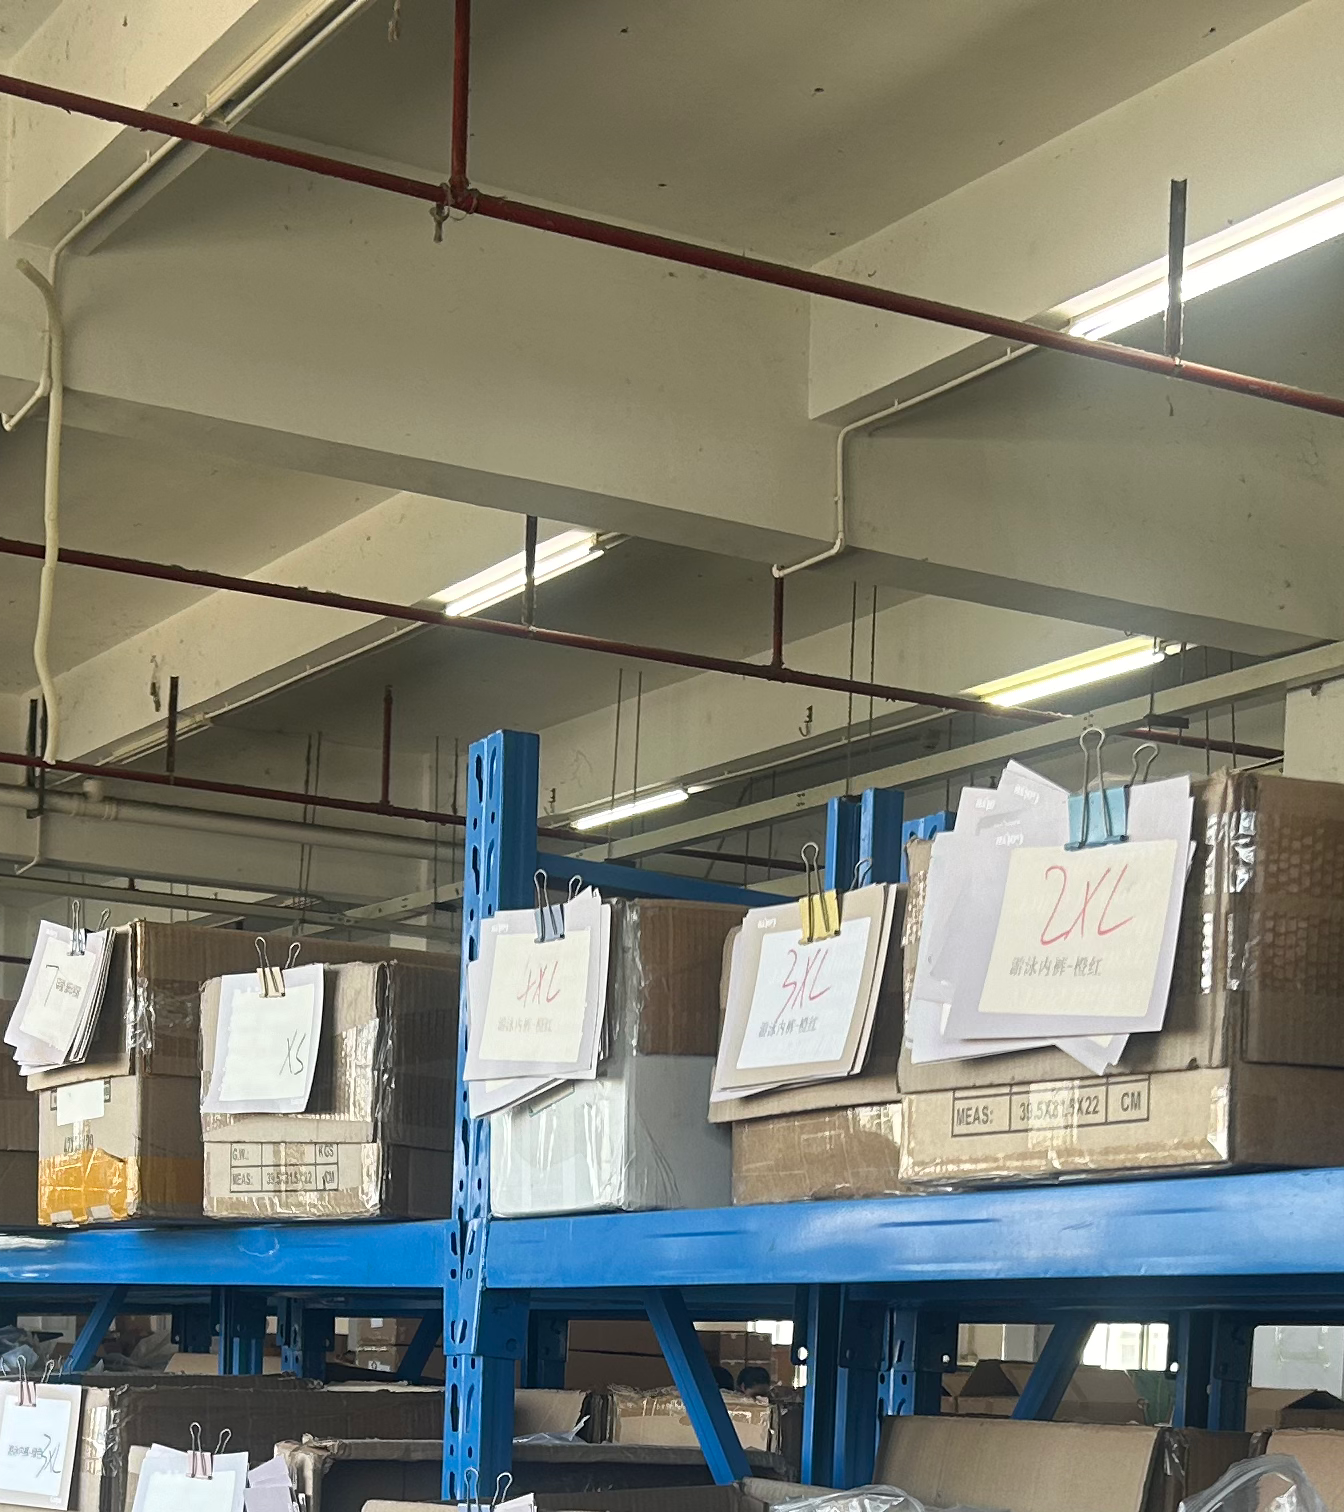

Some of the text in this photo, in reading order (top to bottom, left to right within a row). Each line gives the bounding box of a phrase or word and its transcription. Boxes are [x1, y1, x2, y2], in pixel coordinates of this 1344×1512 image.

[1040, 864, 1136, 946] 2XL
[776, 948, 832, 1023] 3XL
[278, 1028, 306, 1077] XS
[956, 1105, 993, 1126] MEAS:
[1121, 1091, 1142, 1112] CM
